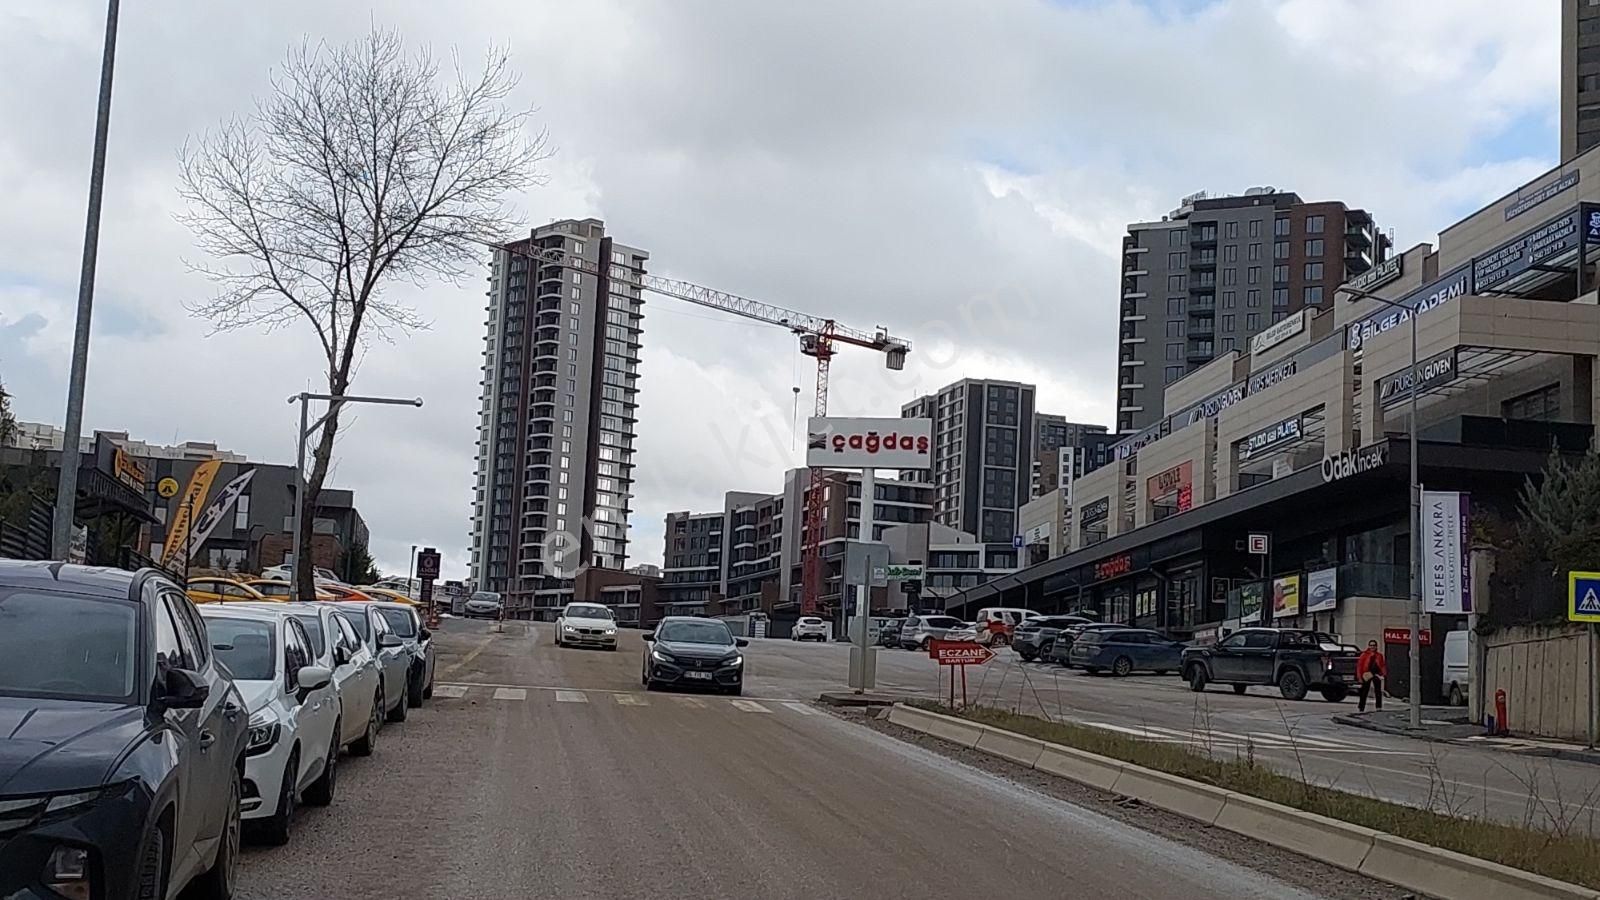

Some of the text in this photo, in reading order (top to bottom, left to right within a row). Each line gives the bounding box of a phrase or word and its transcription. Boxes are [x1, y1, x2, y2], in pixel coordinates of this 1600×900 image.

[1361, 313, 1398, 341] BİLGE
[1398, 276, 1465, 324] AKADEMİ
[832, 431, 929, 455] çağdaş
[1321, 448, 1357, 482] Odak
[1433, 501, 1445, 607] NEFES ANKARA
[1402, 633, 1429, 641] KAUL
[938, 648, 986, 658] ECZANE
